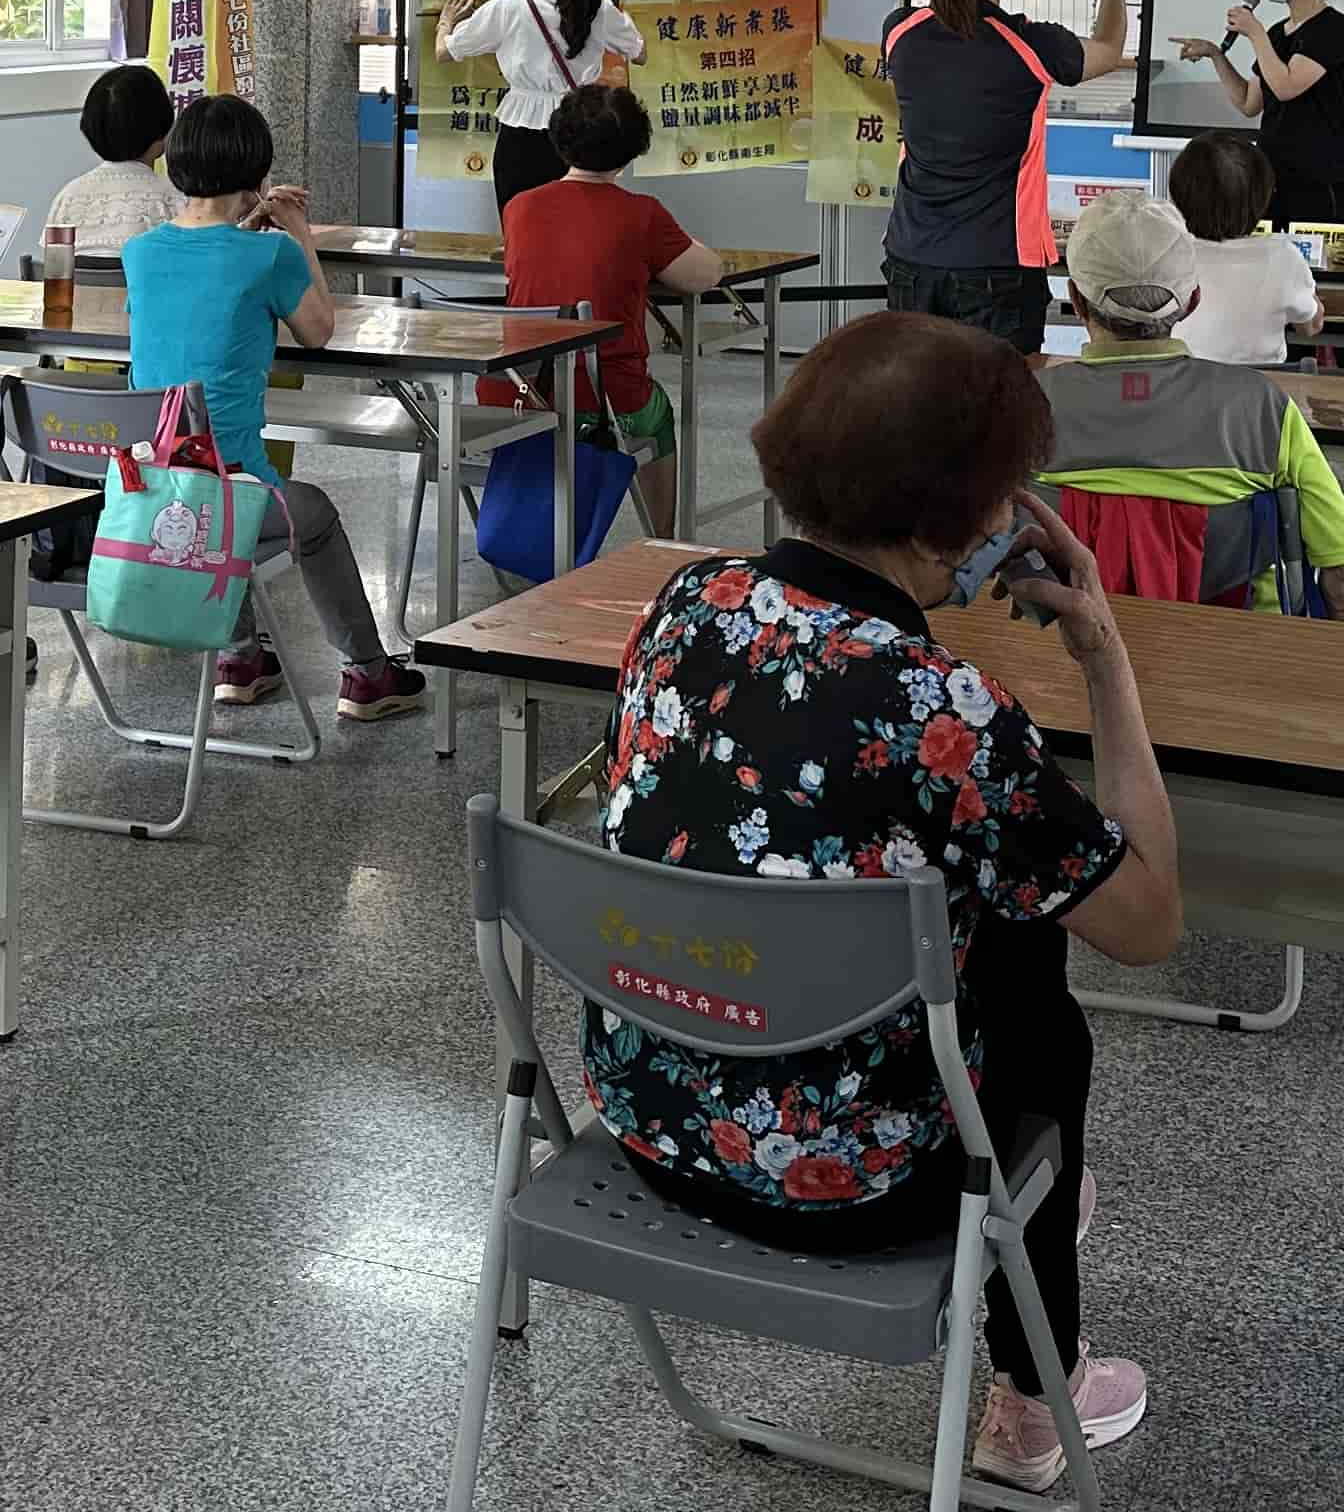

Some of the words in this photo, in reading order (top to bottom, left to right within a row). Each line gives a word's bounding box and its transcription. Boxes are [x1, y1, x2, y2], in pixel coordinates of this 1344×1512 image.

[656, 6, 795, 41] 健康新煮張
[699, 48, 756, 71] 第四招
[660, 72, 800, 104] 自然新鮮享美味
[856, 114, 904, 144] 成
[614, 969, 712, 1015] 彰化縣政府
[723, 1003, 762, 1028] 廣告
